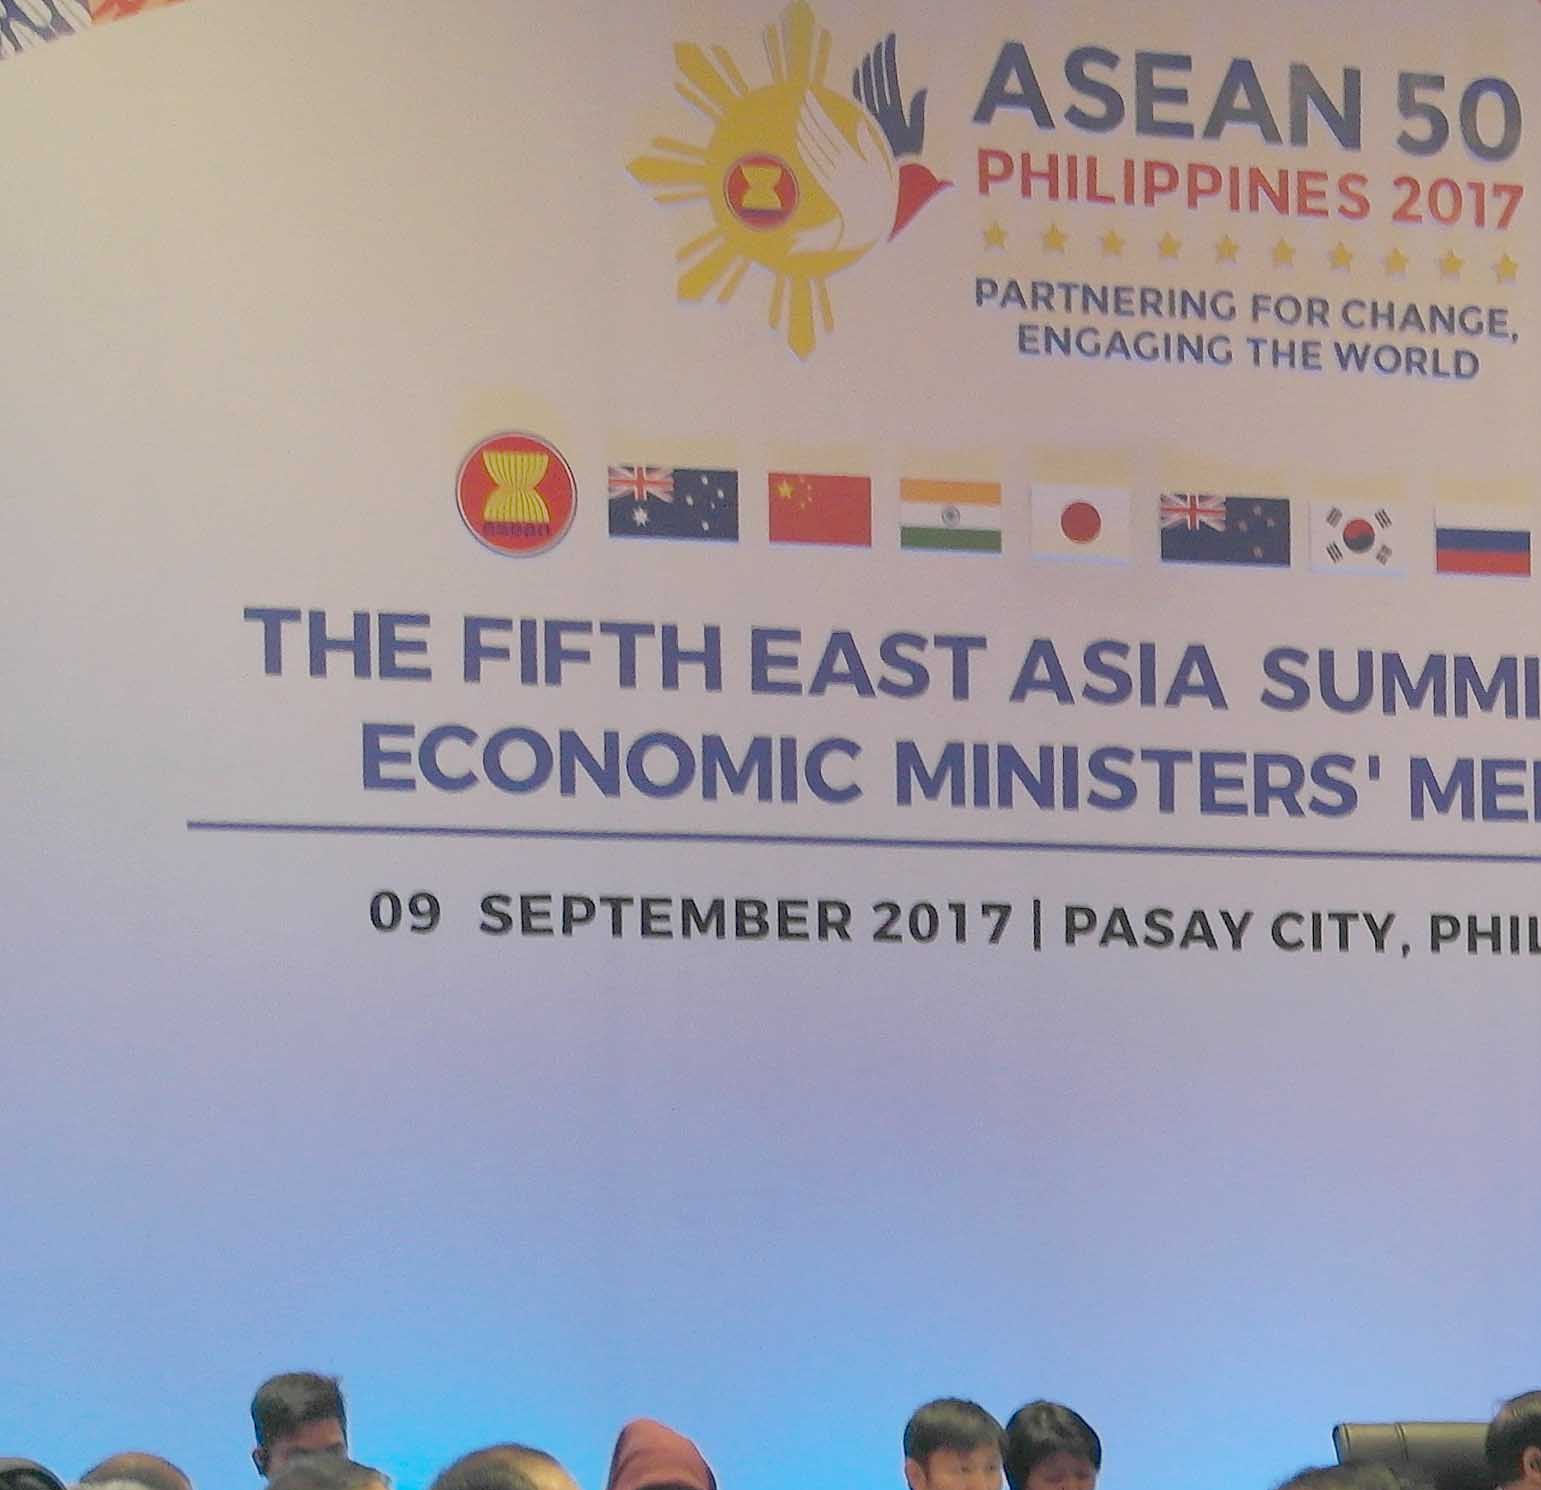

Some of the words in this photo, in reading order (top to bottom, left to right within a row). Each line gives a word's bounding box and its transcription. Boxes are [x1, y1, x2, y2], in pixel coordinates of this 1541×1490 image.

[971, 40, 1362, 151] ASEAN
[1397, 71, 1523, 163] 50
[976, 148, 1371, 219] PHILIPPINES
[1392, 174, 1525, 230] 2017
[974, 276, 1237, 323] PARTNERING
[1250, 292, 1330, 328] FOR
[1341, 298, 1520, 345] CHANGE,
[1017, 323, 1234, 367] ENGAGING
[1246, 337, 1323, 372] THE
[1334, 342, 1480, 381] WORLD
[243, 606, 432, 682] THE
[463, 614, 723, 693] FIFTH
[751, 624, 988, 702] EAST
[1010, 635, 1229, 711] ASIA
[361, 722, 864, 804] ECONOMIC
[895, 740, 1382, 818] MINISTERS'
[369, 889, 442, 934] 09
[479, 893, 854, 944] SEPTEMBER
[872, 899, 1013, 946] 2017
[1064, 904, 1254, 955] PASAY
[1270, 909, 1412, 960] CITY,
